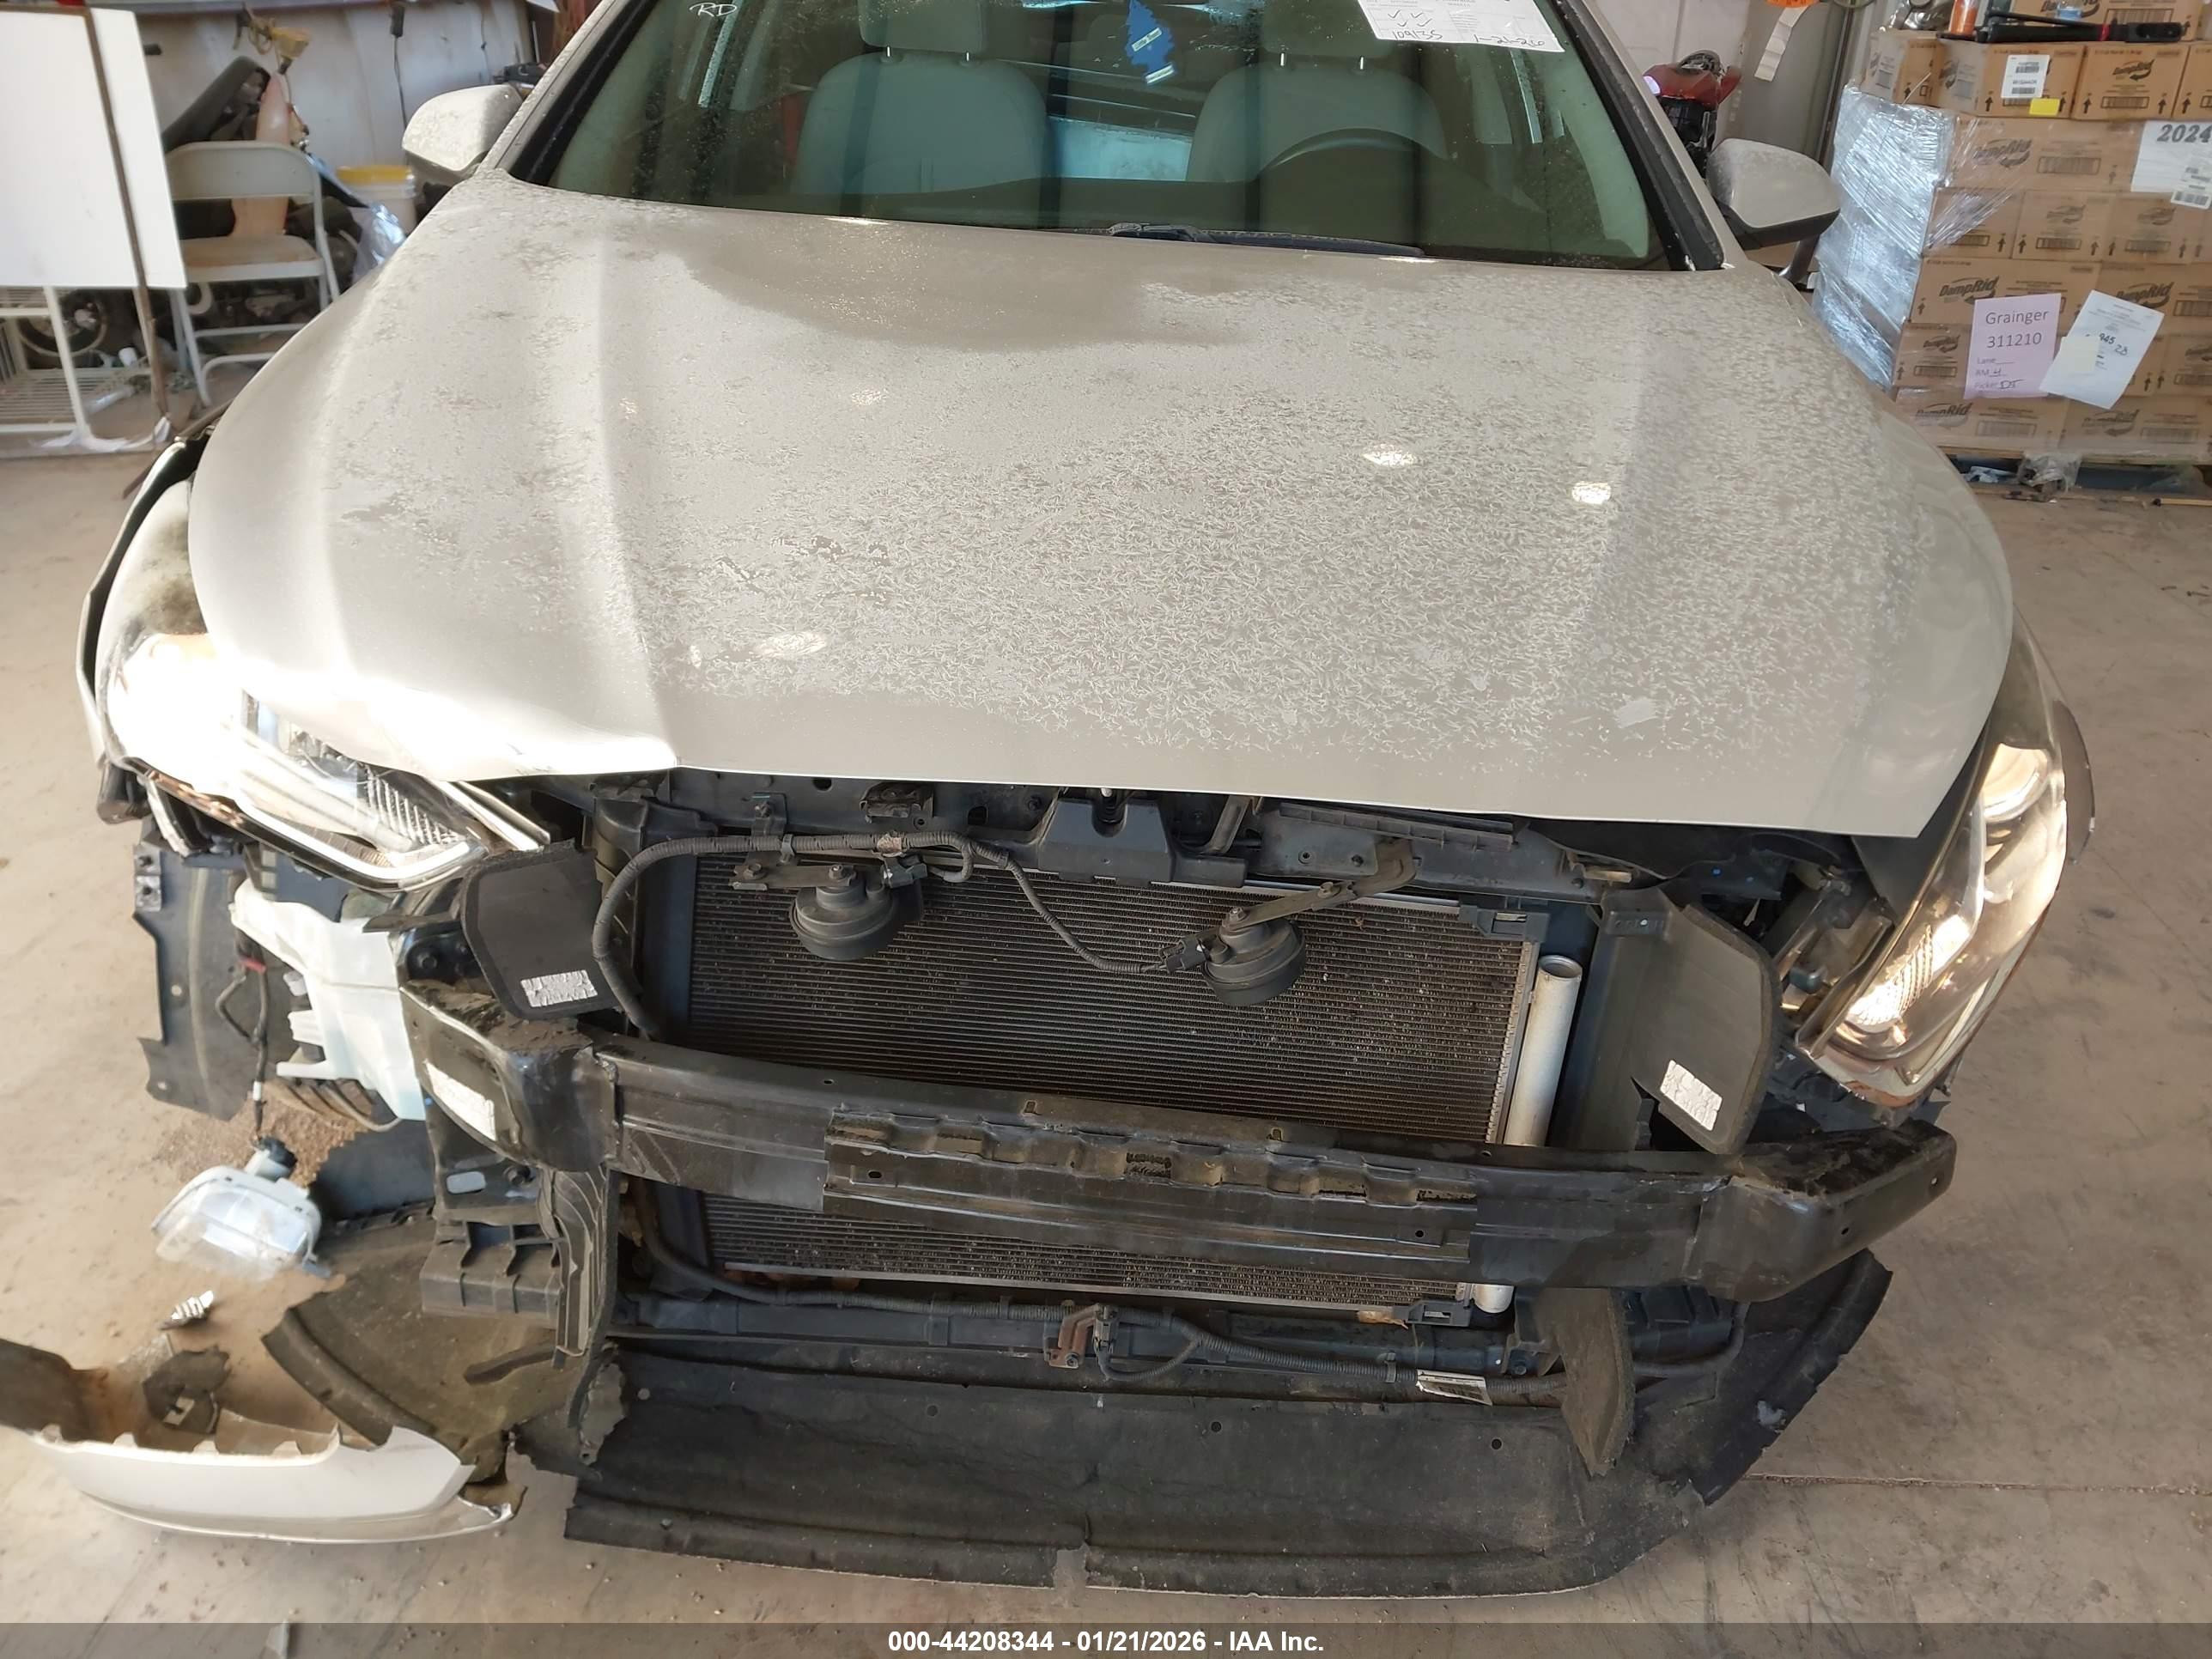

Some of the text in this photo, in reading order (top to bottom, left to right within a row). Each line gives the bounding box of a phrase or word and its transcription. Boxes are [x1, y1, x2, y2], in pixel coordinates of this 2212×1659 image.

[2156, 124, 2212, 143] 2024
[1939, 275, 2000, 297] DampRid
[1985, 310, 2049, 325] Grainger
[1986, 331, 2042, 349] 311210
